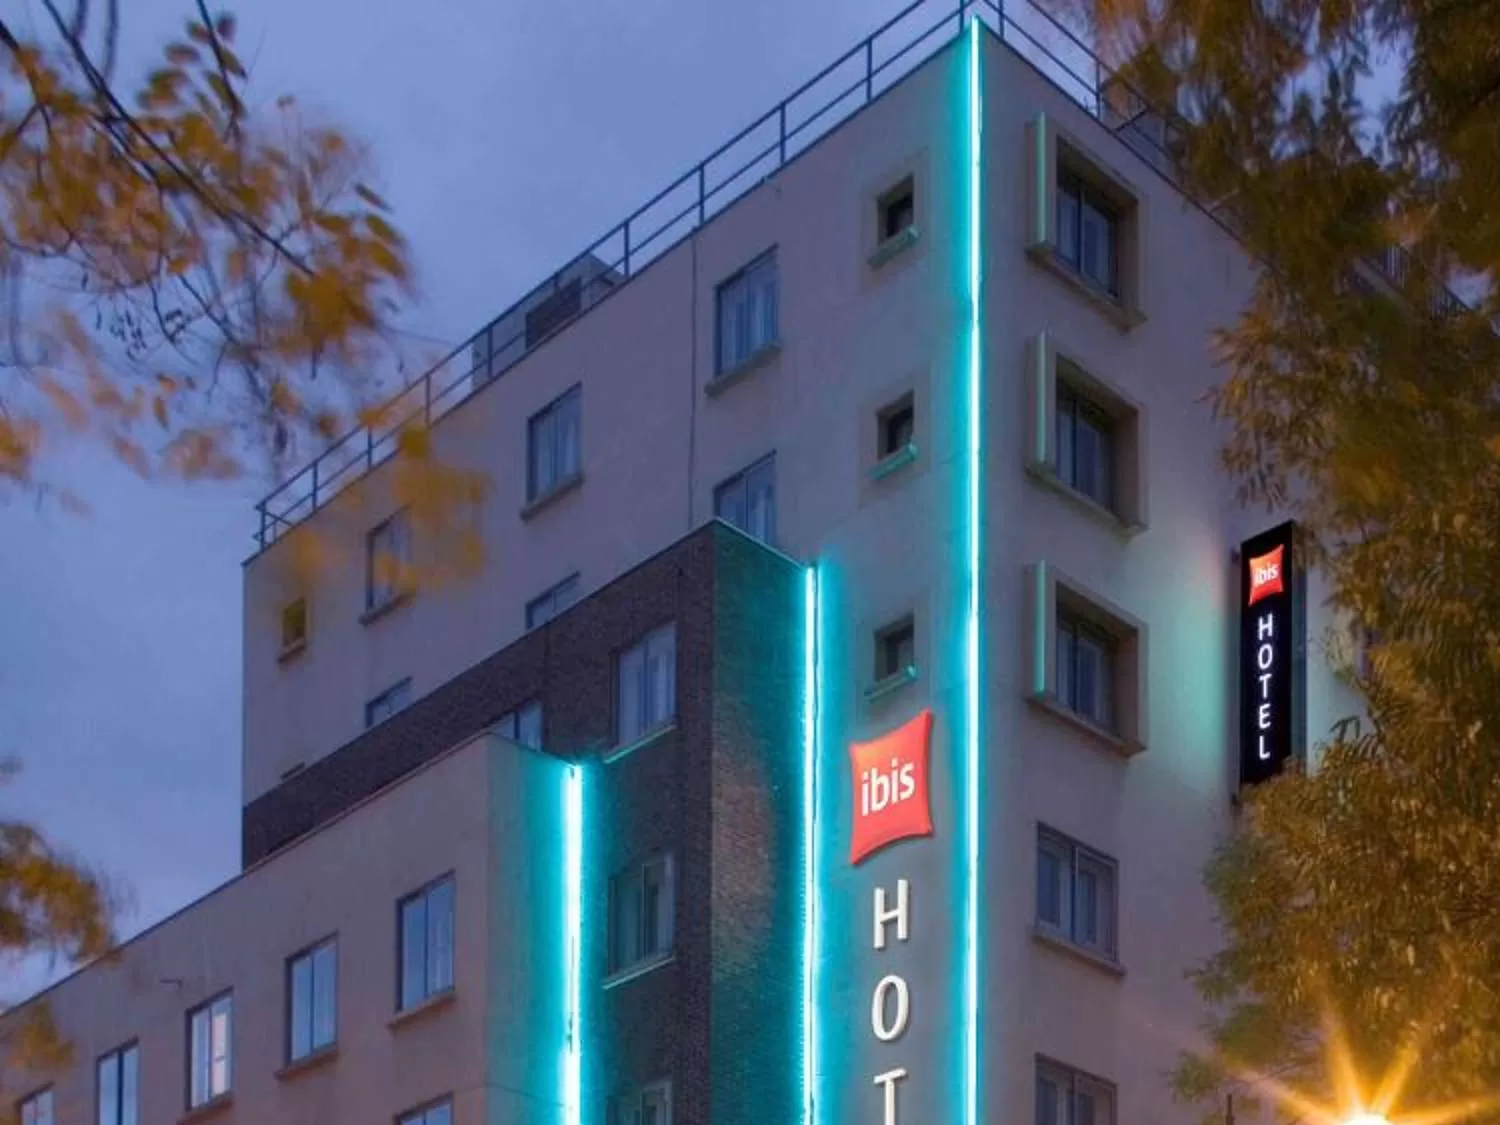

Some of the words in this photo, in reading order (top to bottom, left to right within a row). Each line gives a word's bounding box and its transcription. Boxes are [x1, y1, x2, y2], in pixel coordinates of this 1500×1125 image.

[1253, 563, 1279, 587] ibis
[1257, 613, 1273, 760] HOTEL
[861, 756, 916, 817] ibis
